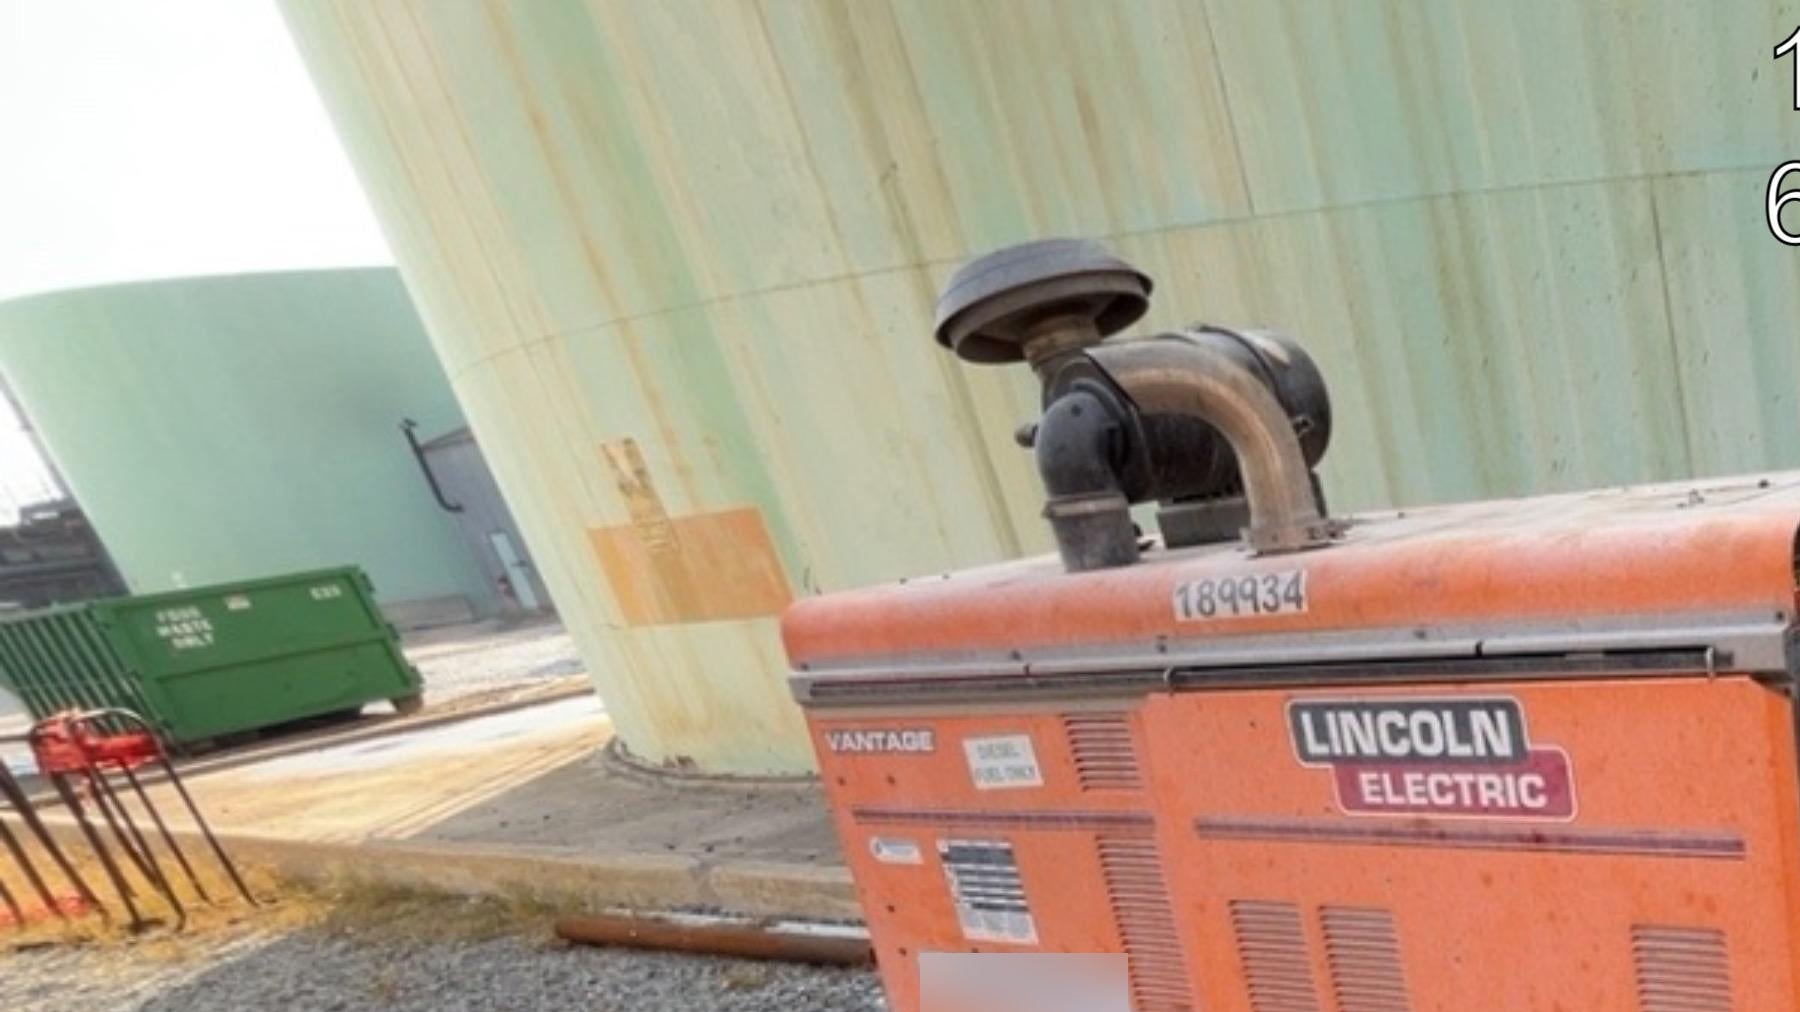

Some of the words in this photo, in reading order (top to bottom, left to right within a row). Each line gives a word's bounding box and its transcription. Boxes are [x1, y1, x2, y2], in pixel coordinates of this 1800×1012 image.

[1176, 571, 1303, 618] 189934
[826, 731, 934, 752] VANTAGE
[1300, 709, 1513, 757] LINCOLN
[1359, 771, 1547, 808] ELECTRIC
